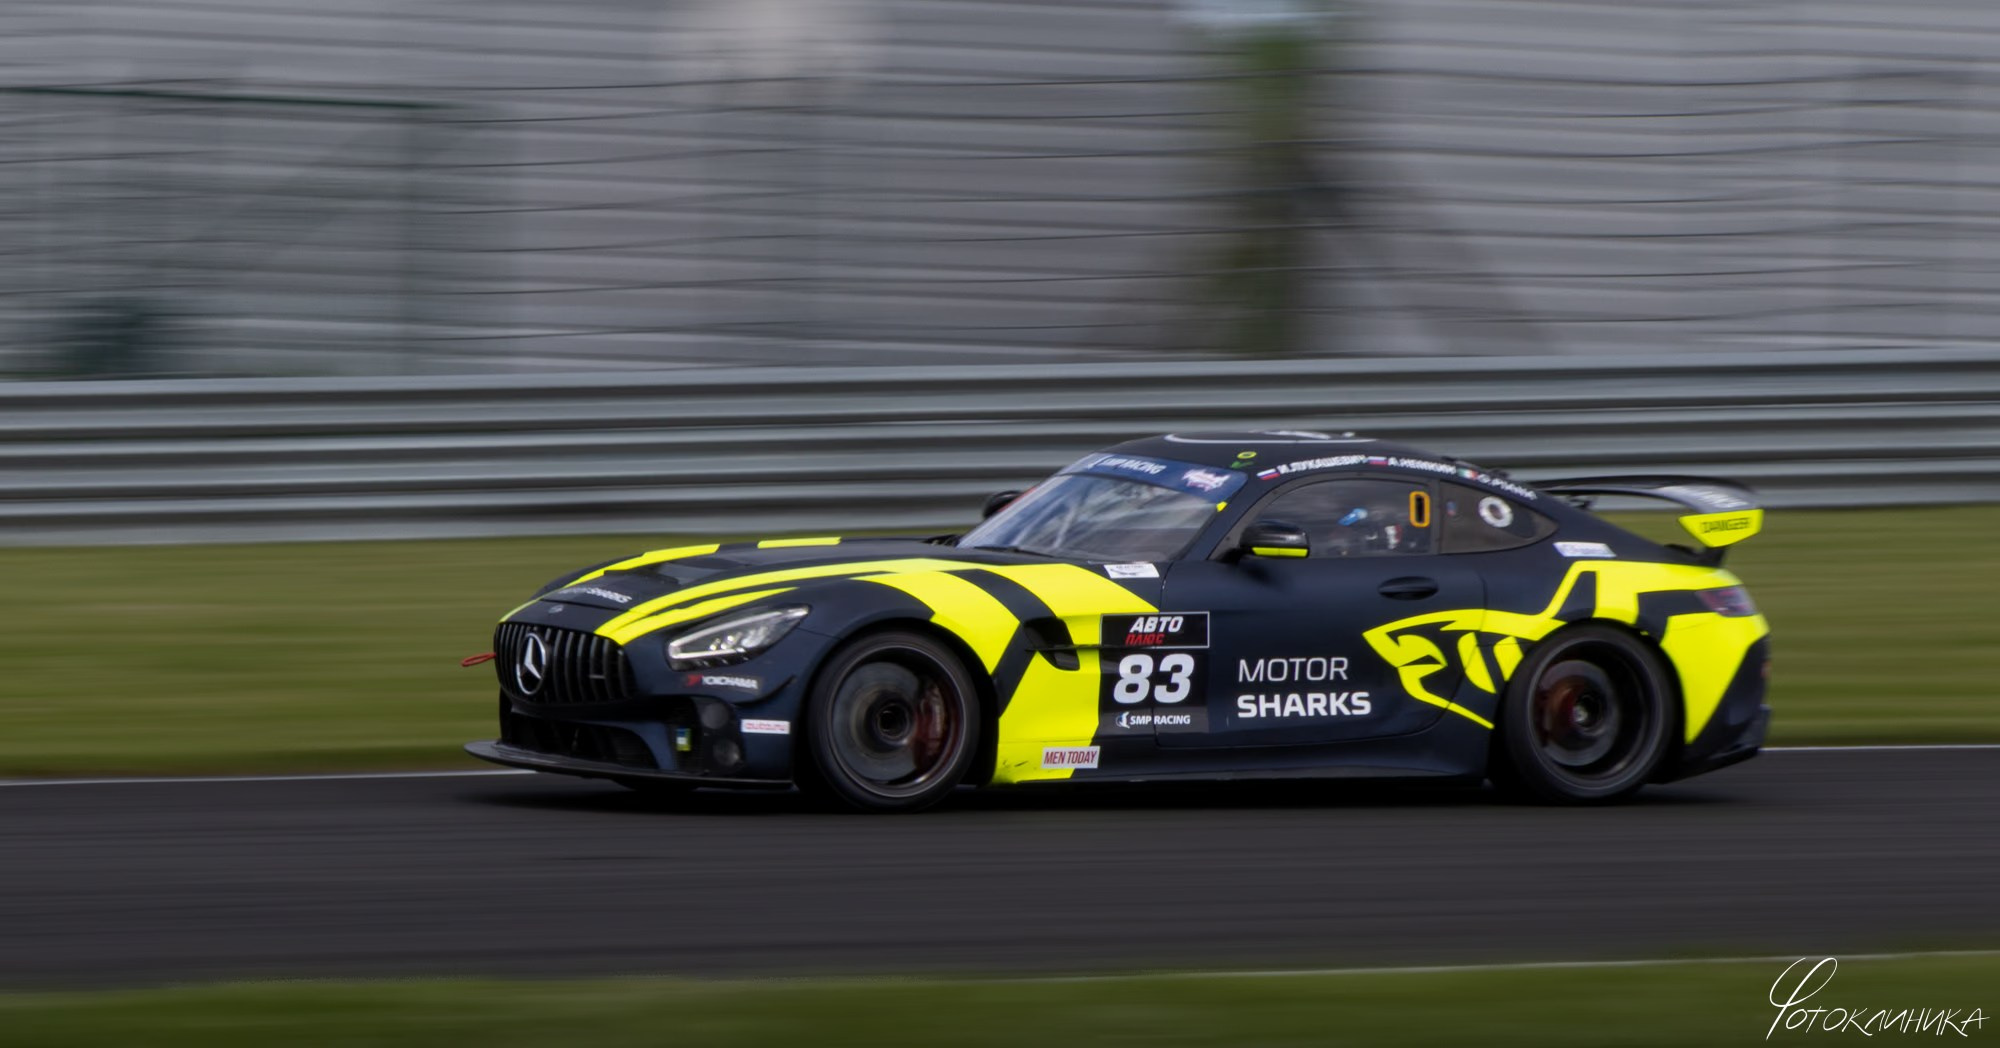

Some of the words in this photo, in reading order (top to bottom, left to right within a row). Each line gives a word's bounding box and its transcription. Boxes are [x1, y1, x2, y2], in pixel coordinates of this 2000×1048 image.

[1121, 459, 1167, 475] RACING
[1129, 616, 1184, 633] АВТО
[1238, 656, 1349, 683] MOTOR
[1113, 653, 1195, 704] 83
[1237, 691, 1372, 718] SHARKS
[1130, 715, 1152, 725] SMP
[1153, 715, 1191, 725] RACING
[1044, 751, 1067, 765] MEN
[1067, 750, 1098, 764] TODAY
